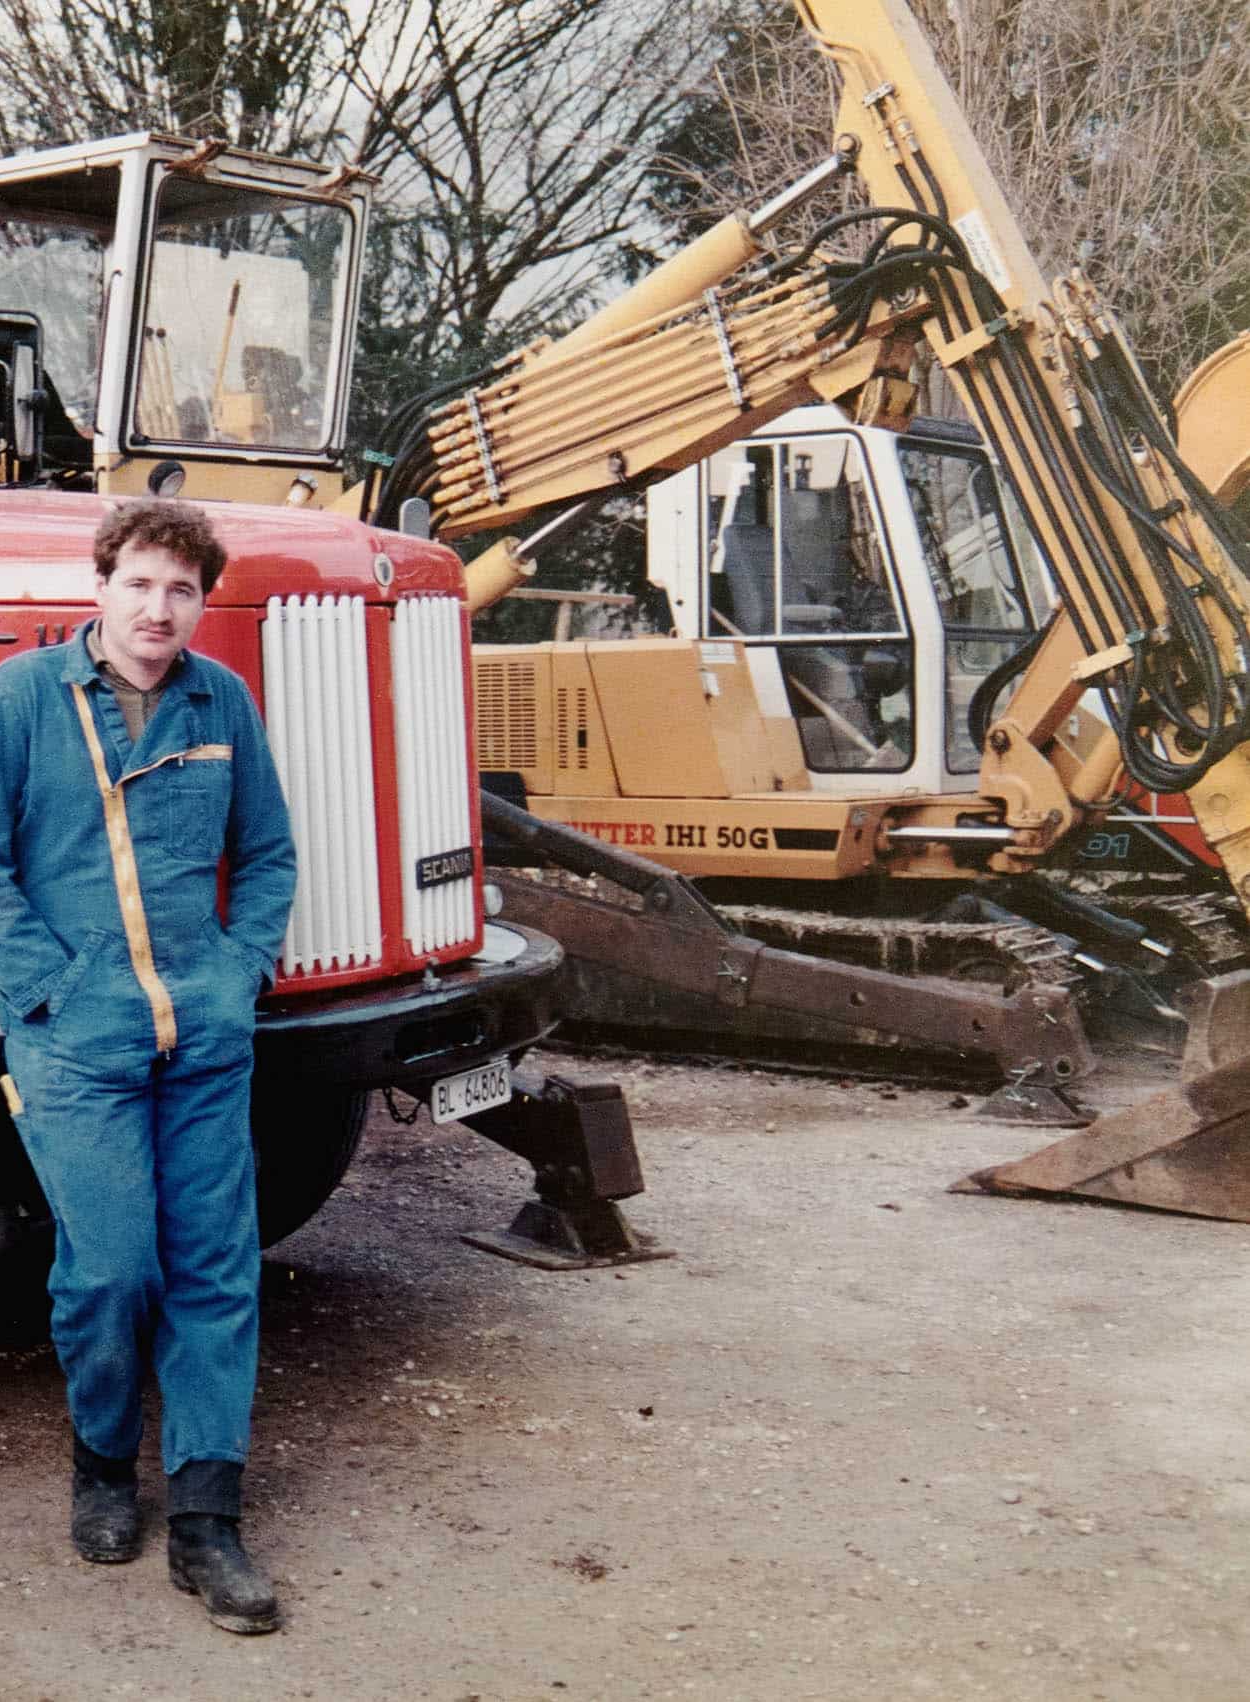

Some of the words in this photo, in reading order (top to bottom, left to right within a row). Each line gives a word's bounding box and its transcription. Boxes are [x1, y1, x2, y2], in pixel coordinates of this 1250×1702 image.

[563, 821, 655, 845] TTER
[665, 824, 707, 847] IHI
[717, 826, 769, 849] 50G
[465, 1068, 506, 1107] 64806
